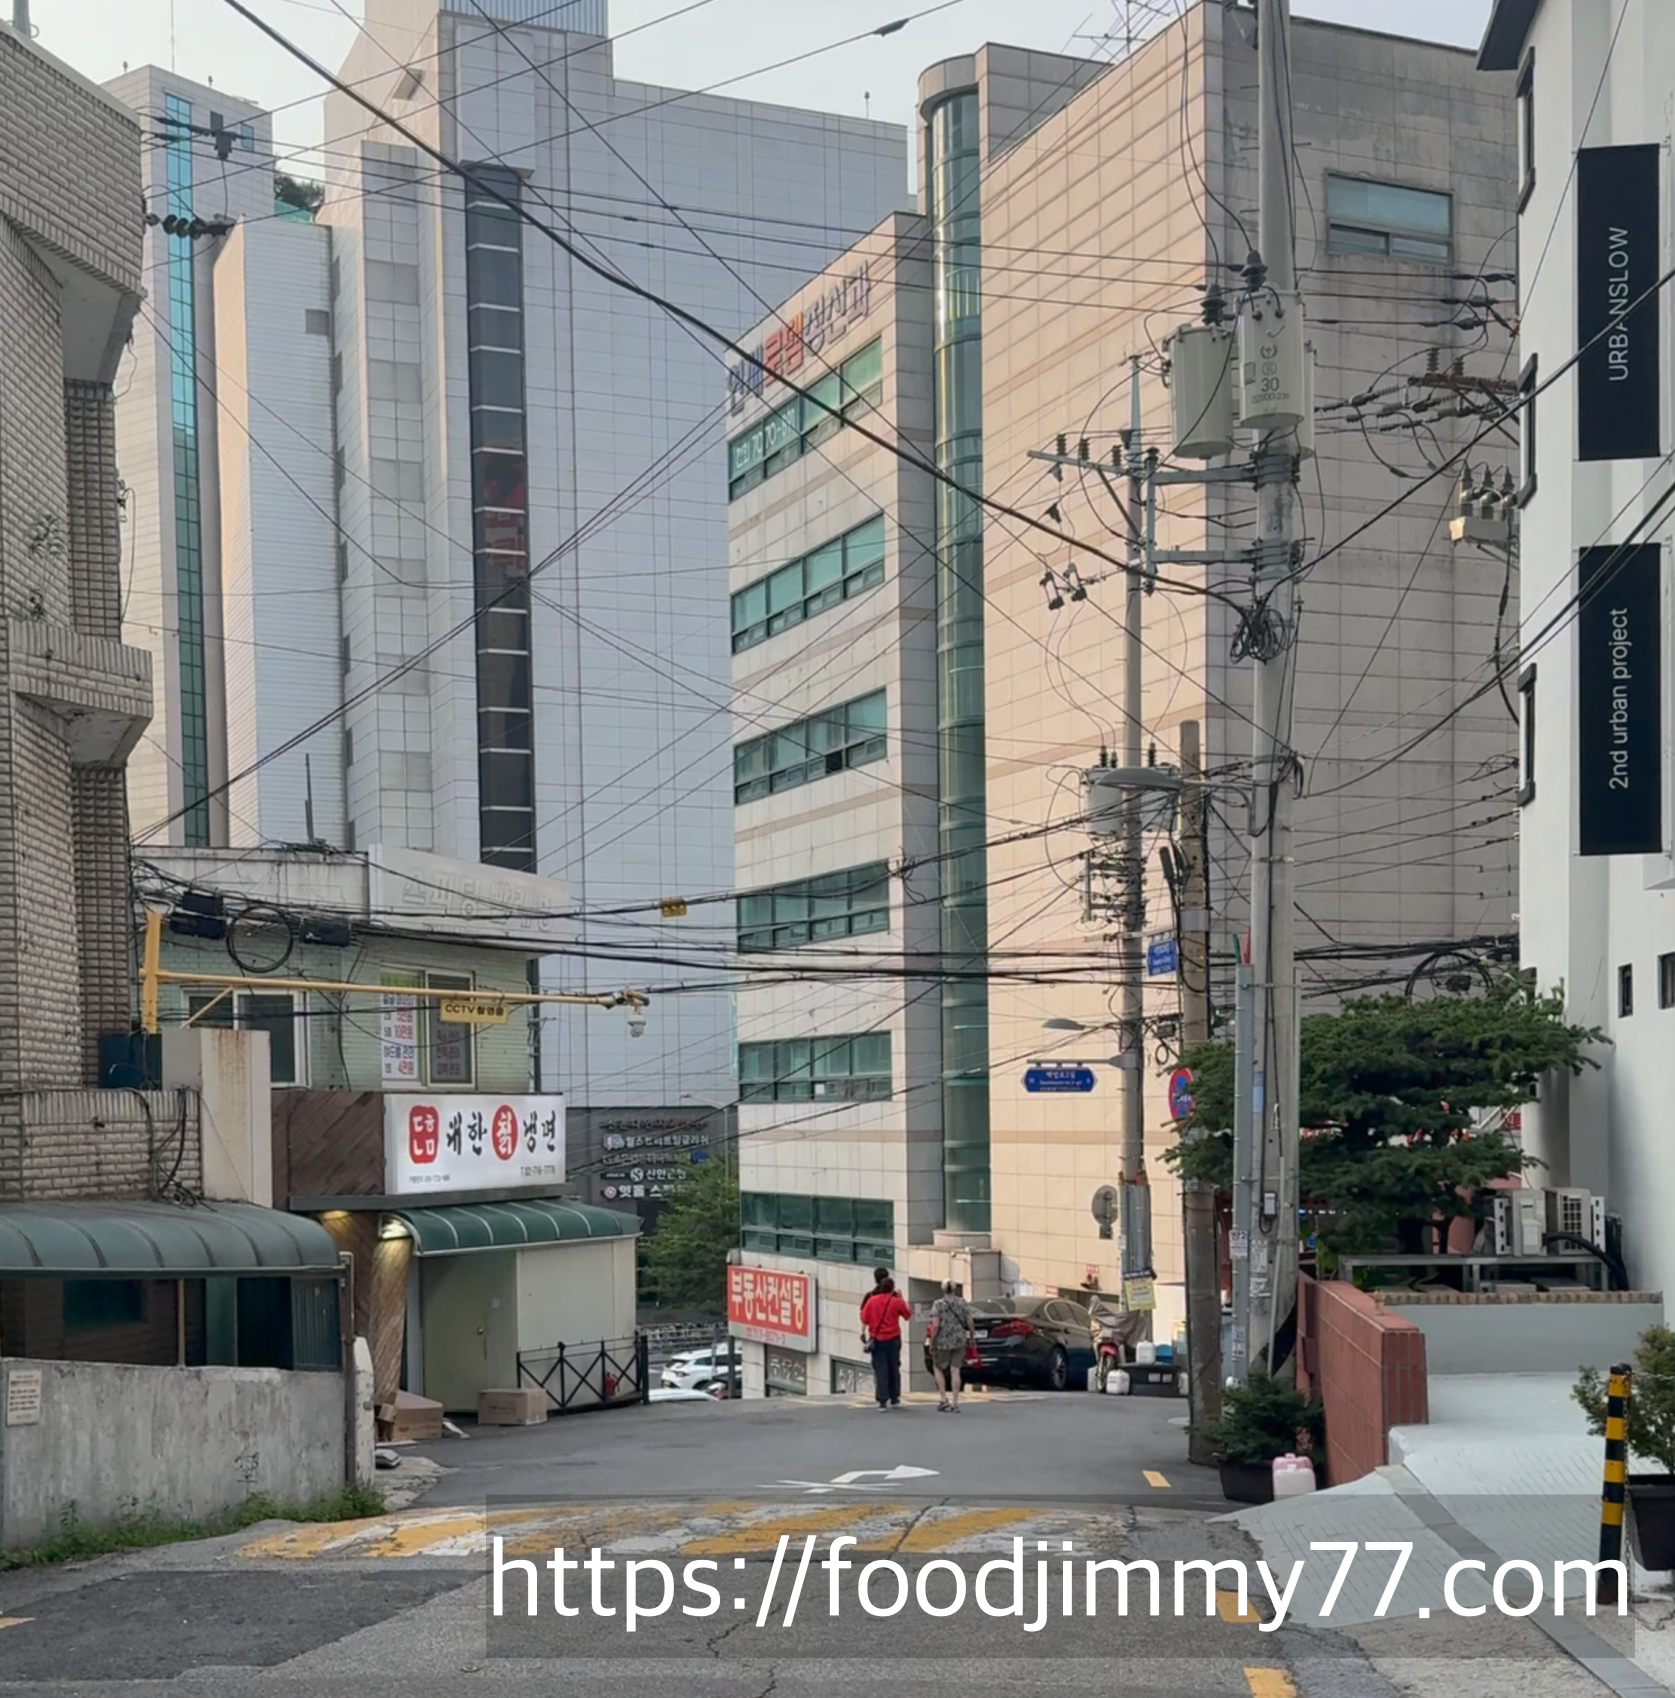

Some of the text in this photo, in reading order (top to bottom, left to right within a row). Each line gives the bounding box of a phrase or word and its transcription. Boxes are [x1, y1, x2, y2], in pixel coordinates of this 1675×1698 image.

[1609, 227, 1628, 380] URBANSLOW
[1261, 377, 1279, 392] 30
[1608, 608, 1633, 789] 2nd urban project
[445, 1004, 475, 1013] CCTV
